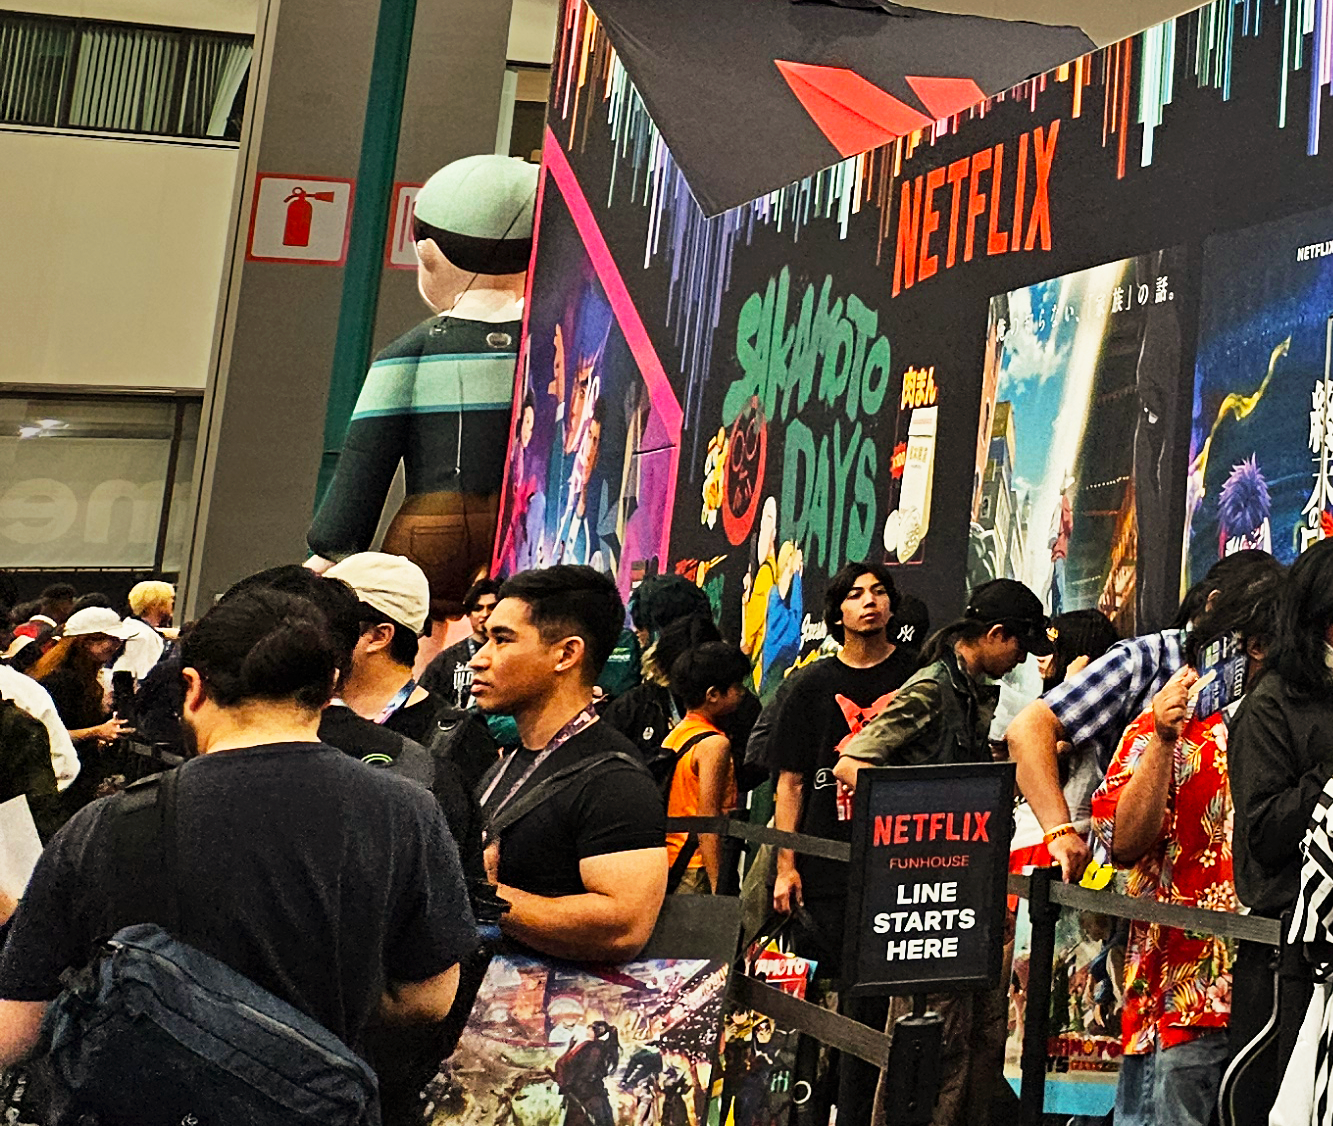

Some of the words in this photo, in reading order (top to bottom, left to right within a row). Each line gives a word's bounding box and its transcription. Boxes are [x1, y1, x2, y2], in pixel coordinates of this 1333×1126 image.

[892, 119, 1061, 298] NETFLIX
[722, 265, 890, 427] SAKAMOTO
[901, 365, 937, 411] 肉まん
[779, 419, 877, 578] DAYS
[873, 811, 991, 847] NETFLIX
[889, 855, 969, 870] FUNHOUSE
[896, 882, 958, 905] LINE
[873, 908, 976, 934] STARTS
[886, 937, 959, 961] HERE
